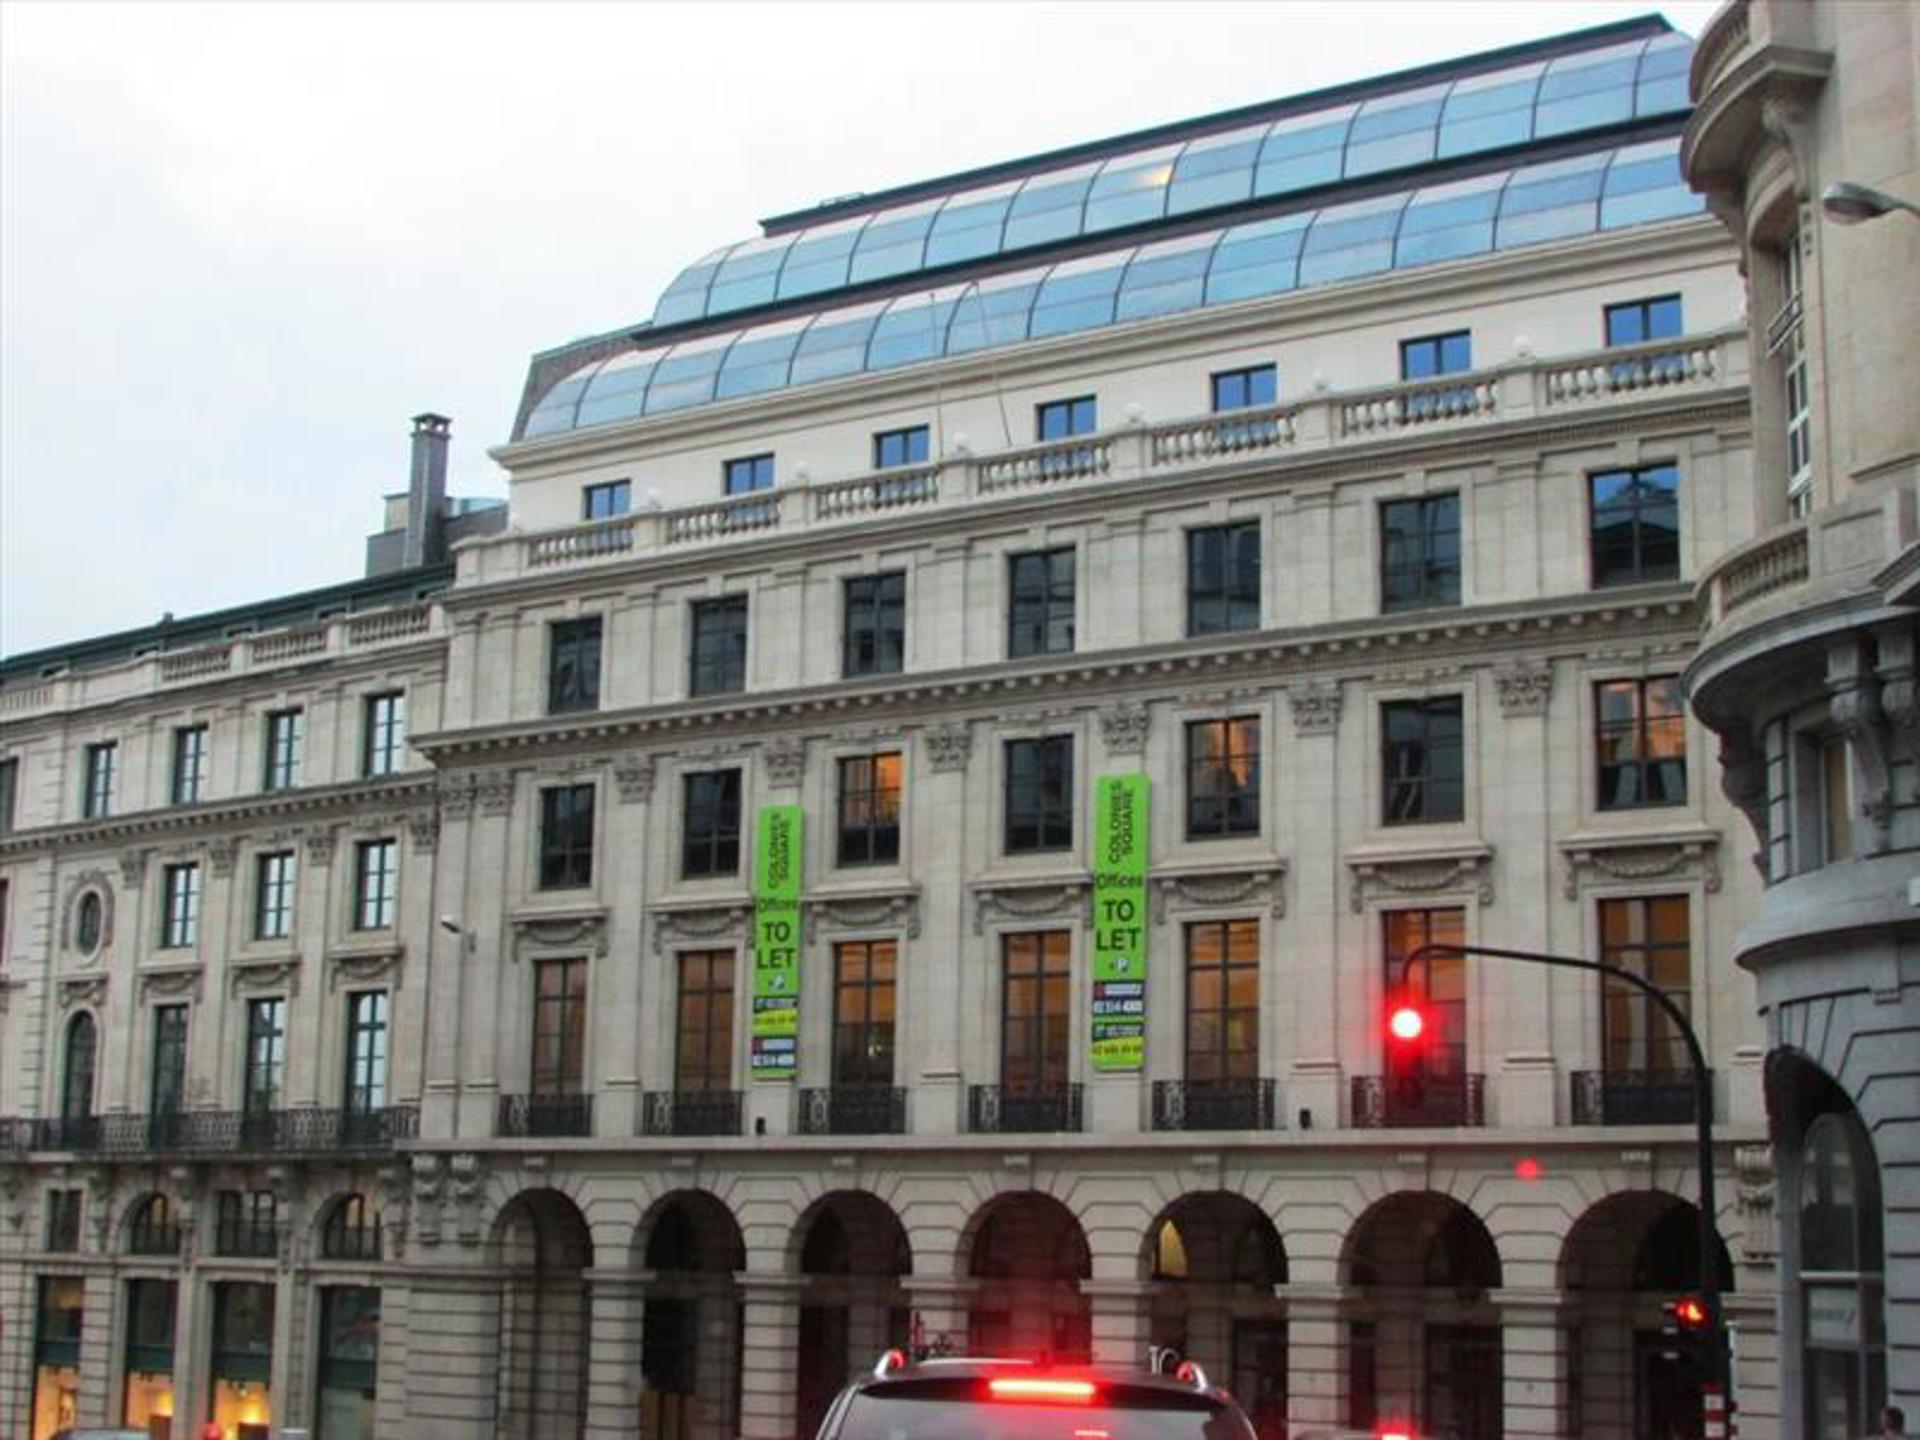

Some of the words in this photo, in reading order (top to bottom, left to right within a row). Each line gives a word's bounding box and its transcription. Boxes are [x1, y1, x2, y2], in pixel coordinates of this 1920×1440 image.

[1102, 899, 1135, 922] TO
[761, 921, 791, 942] TO
[1096, 927, 1141, 951] LET
[757, 947, 796, 969] LET
